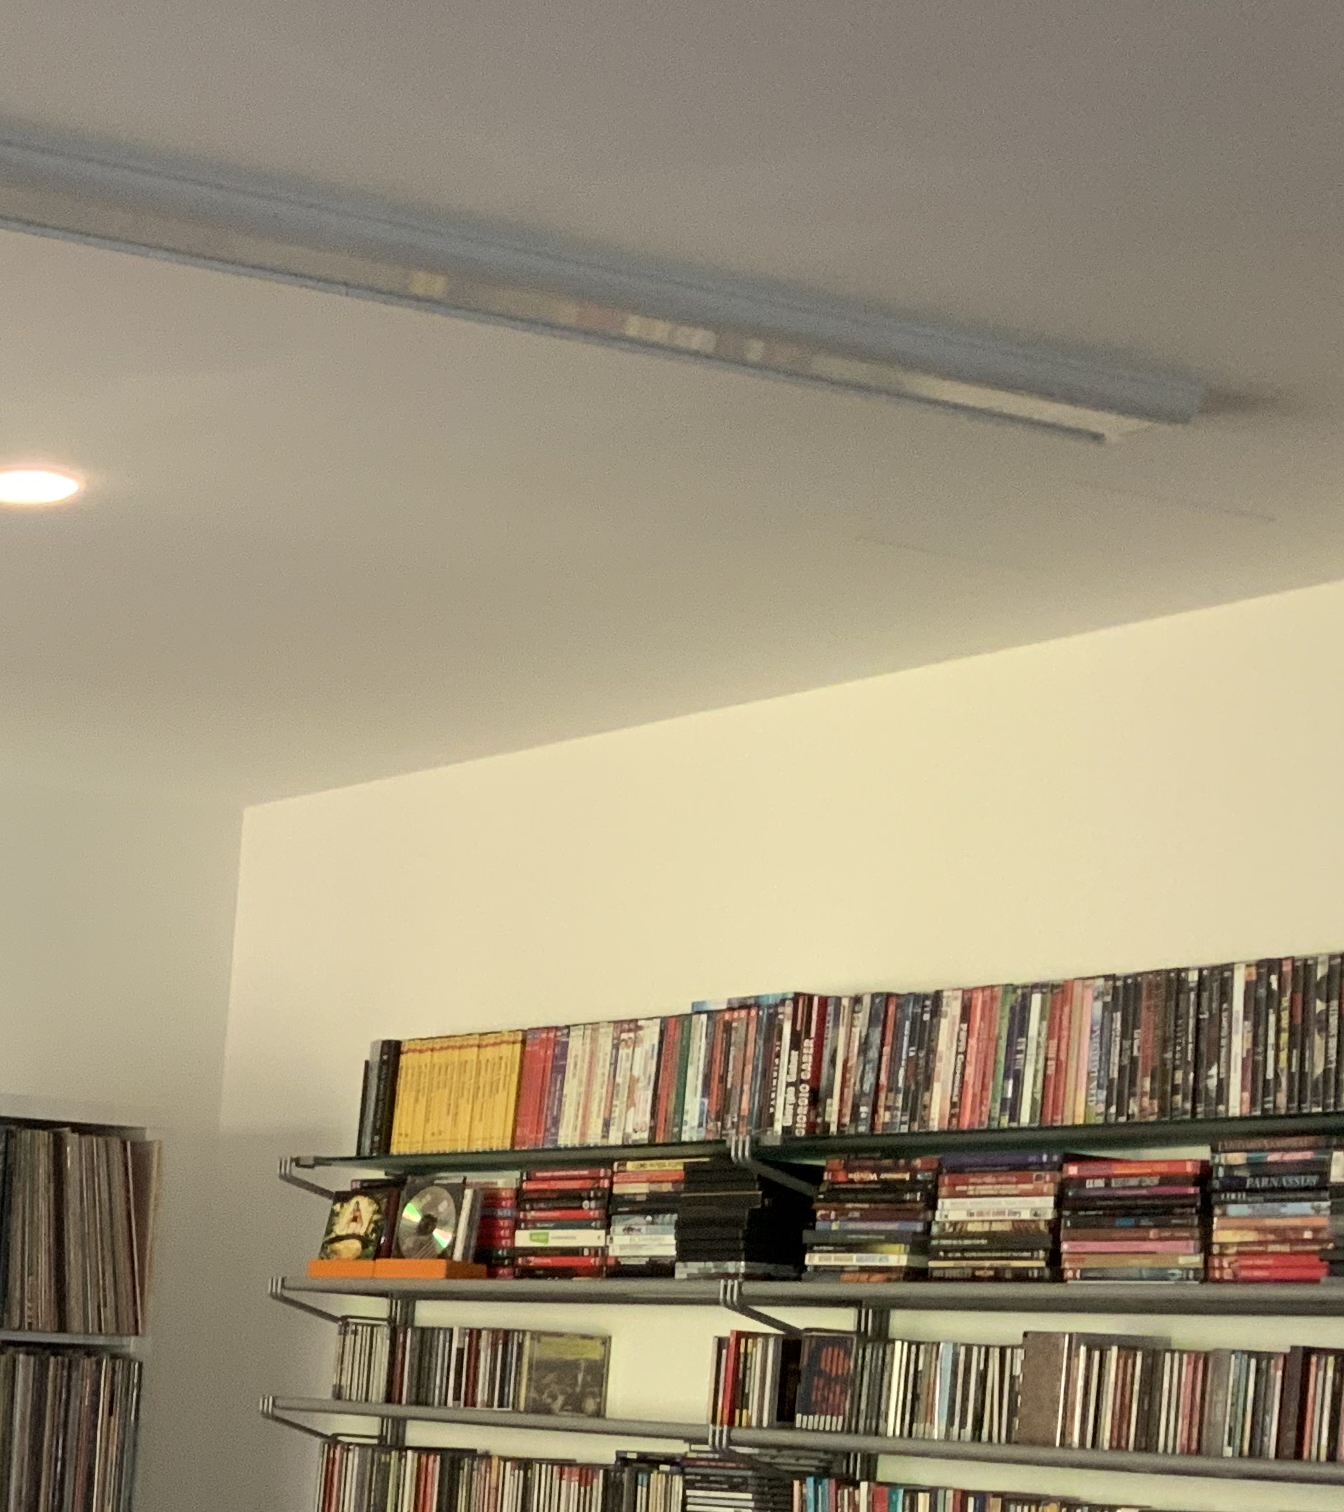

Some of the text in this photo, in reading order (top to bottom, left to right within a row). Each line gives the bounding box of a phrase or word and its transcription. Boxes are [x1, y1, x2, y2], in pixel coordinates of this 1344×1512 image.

[783, 1050, 798, 1126] Giorgio Gaber
[795, 1039, 813, 1137] GIORGIO GABER
[1246, 1176, 1318, 1188] PARNASSUS
